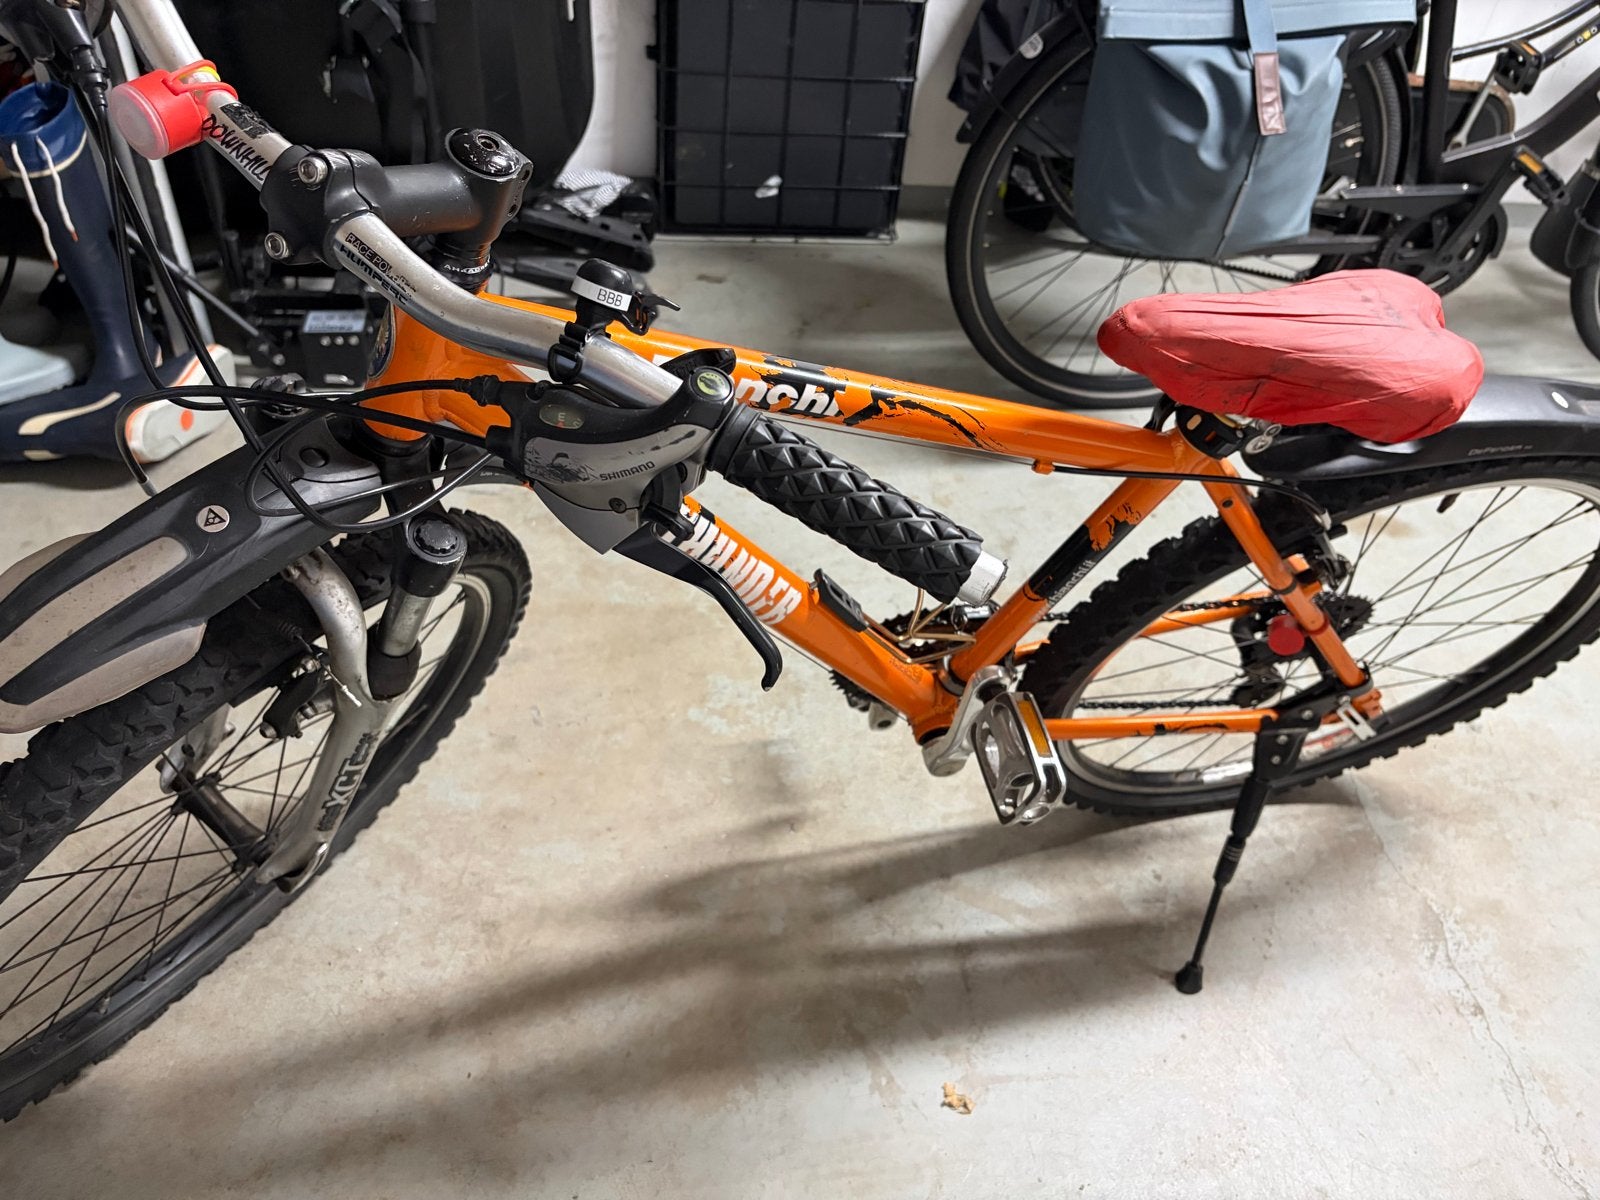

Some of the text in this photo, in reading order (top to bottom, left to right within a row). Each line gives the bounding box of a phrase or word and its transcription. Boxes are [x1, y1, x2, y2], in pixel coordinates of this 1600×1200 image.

[202, 113, 272, 182] DOWNHILL
[345, 233, 375, 260] RACE
[597, 288, 623, 307] BBB
[599, 460, 656, 482] SHIMANO
[323, 758, 367, 807] XCT
